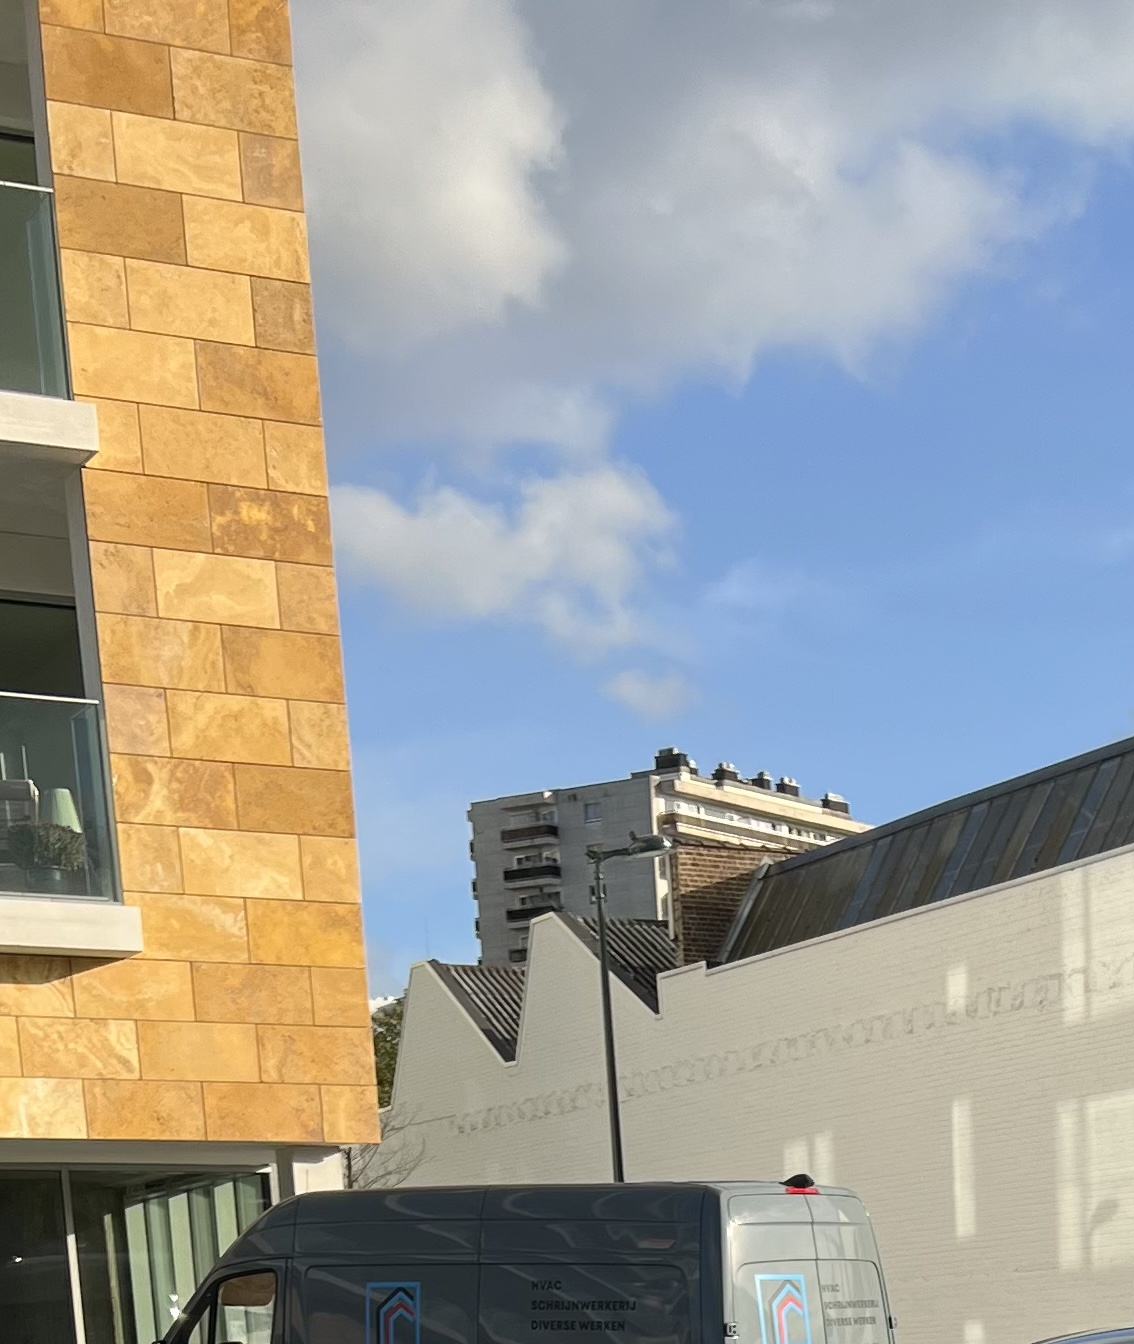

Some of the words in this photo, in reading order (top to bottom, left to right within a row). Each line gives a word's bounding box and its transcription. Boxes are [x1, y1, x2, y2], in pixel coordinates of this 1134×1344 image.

[531, 1280, 562, 1291] HVAC
[530, 1300, 637, 1312] SCHRIJNWERKERIJ
[530, 1320, 577, 1331] DIVERSE
[578, 1320, 625, 1332] WERKEN
